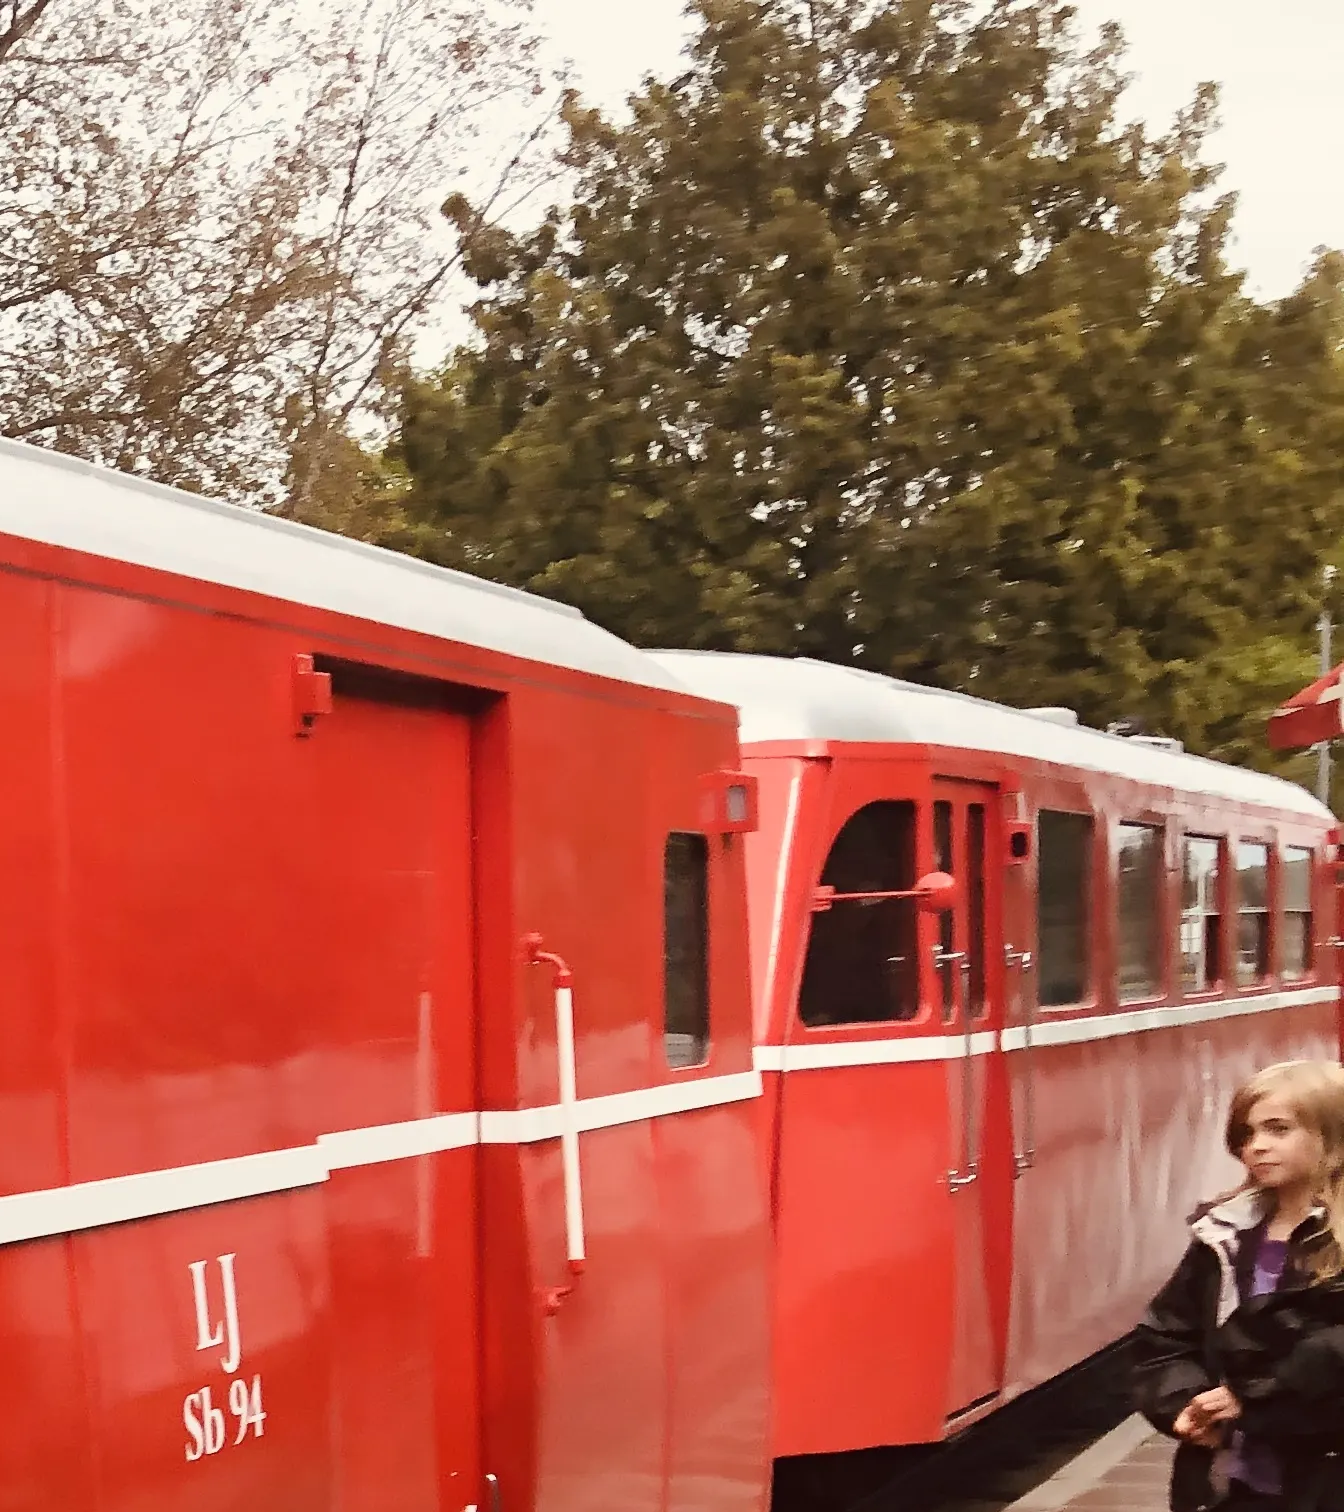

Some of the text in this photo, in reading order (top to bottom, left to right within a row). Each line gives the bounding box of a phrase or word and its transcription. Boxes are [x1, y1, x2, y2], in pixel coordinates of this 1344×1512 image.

[188, 1252, 242, 1374] LJ
[183, 1373, 267, 1462] Sb 94
